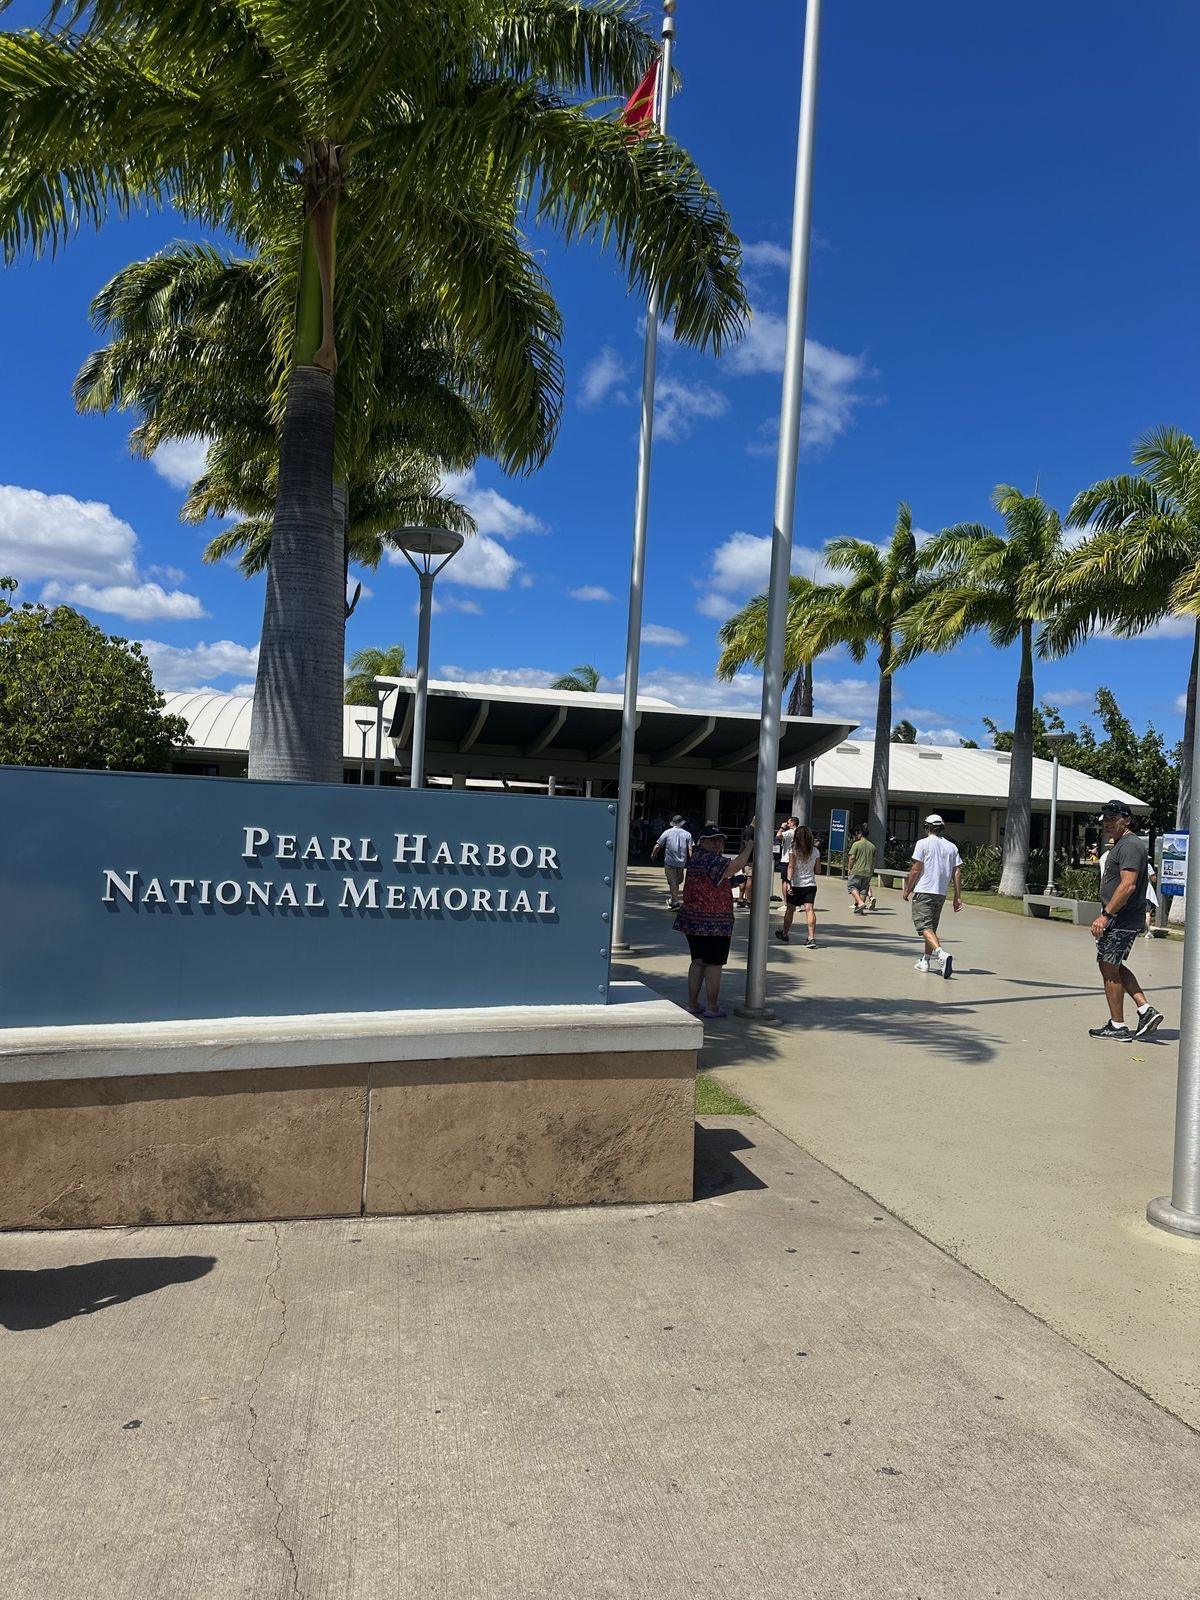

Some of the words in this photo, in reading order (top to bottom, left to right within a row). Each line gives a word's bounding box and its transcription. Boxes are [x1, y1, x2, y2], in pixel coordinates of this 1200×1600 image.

[241, 826, 379, 862] PEARL
[392, 833, 559, 869] HARBOR
[101, 869, 325, 907] NATIONAL
[338, 877, 557, 914] MEMORIAL
